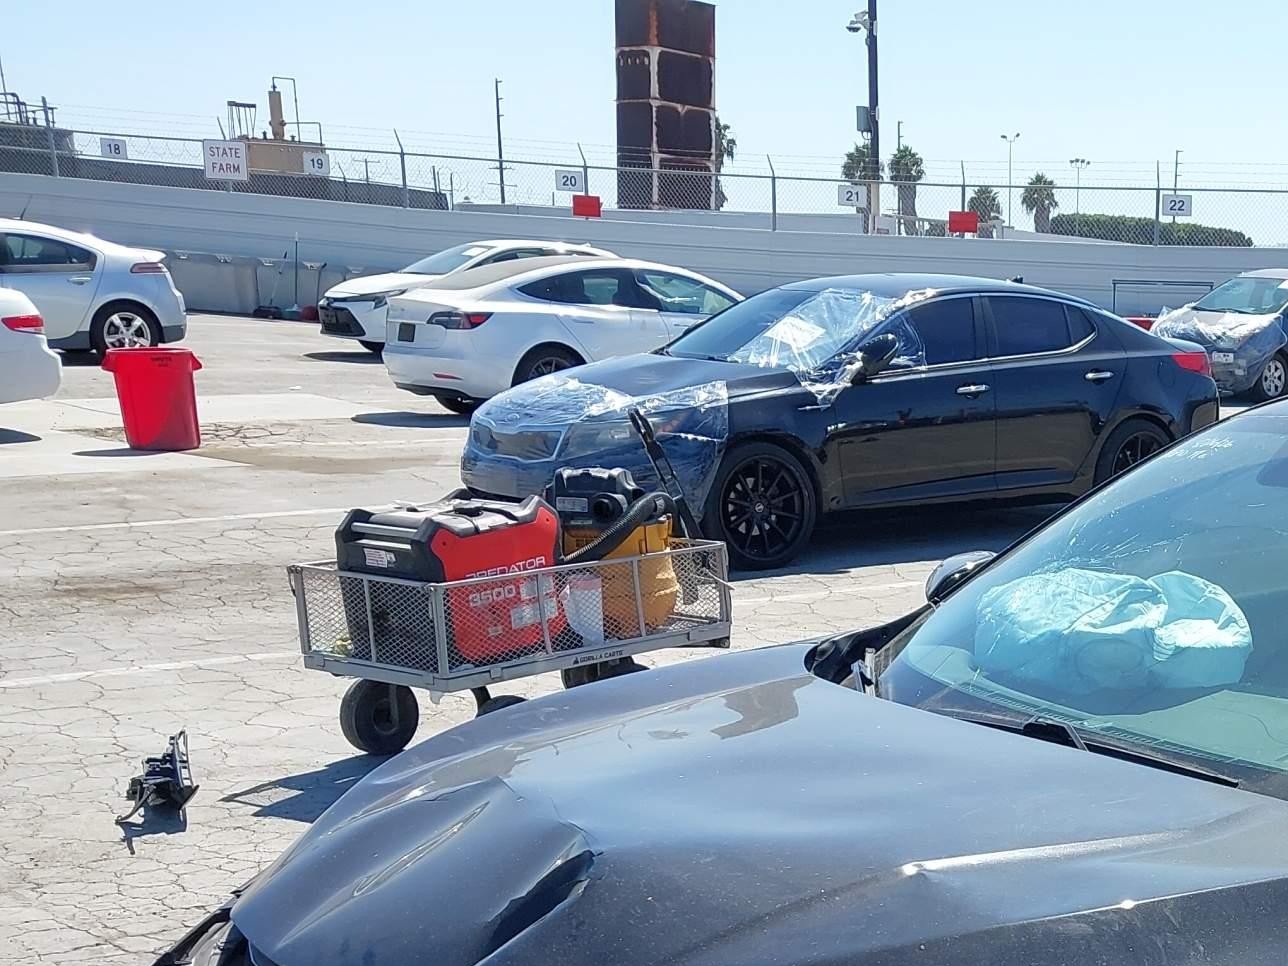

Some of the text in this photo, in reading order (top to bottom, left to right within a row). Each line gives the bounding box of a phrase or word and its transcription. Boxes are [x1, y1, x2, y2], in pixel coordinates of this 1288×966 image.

[107, 143, 121, 155] 18
[208, 146, 241, 158] STATE
[211, 162, 241, 174] FARM
[310, 157, 324, 169] 19
[562, 175, 577, 187] 20
[846, 190, 859, 202] 21
[1169, 199, 1185, 211] 22
[469, 585, 516, 607] 3500
